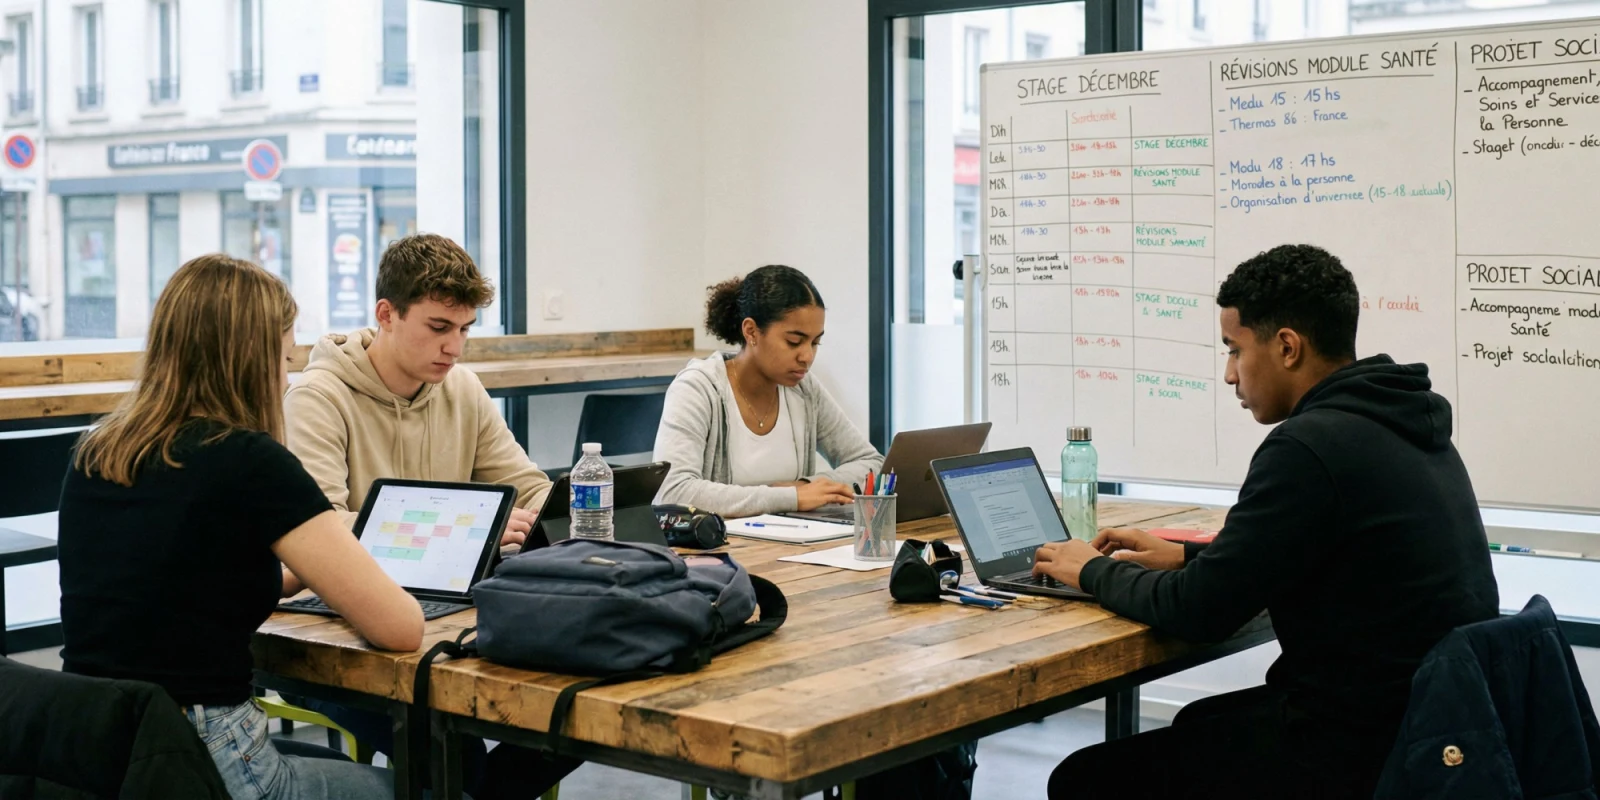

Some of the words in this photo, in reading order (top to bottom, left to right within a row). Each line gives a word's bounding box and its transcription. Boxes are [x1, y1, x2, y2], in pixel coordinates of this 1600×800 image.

[1471, 39, 1542, 64] PROJET
[1554, 33, 1600, 57] SOCI
[1220, 58, 1298, 81] RÉVISIONS
[1308, 54, 1369, 75] MODULE
[1381, 42, 1438, 69] SANTÉ
[1017, 76, 1068, 99] STAGE
[1078, 69, 1161, 93] DÉCEMBRE
[1270, 91, 1286, 105] 15
[1303, 88, 1321, 102] 15
[1479, 97, 1518, 112] Soins
[1525, 94, 1539, 109] et
[1313, 109, 1348, 122] France
[1480, 116, 1494, 131] la
[1502, 114, 1568, 130] Personne
[1134, 139, 1160, 149] STAGE
[1166, 136, 1208, 149] DÉCEMBRE
[1133, 166, 1169, 177] RÉVISIONS
[1171, 168, 1200, 176] MODULE
[1230, 159, 1261, 174] Modu
[1267, 156, 1283, 170] 18
[1300, 154, 1316, 167] 17
[1152, 177, 1177, 187] SANTÉ
[1292, 173, 1302, 186] la
[1306, 173, 1355, 191] personne
[1230, 192, 1297, 214] Organisation
[1135, 224, 1177, 236] RÉVISIONS
[1136, 238, 1165, 247] MODULE
[1467, 262, 1532, 284] PROJET
[991, 296, 1008, 310] 15h
[1135, 292, 1161, 303] STAGE
[1156, 306, 1184, 319] SANTÉ
[1470, 298, 1561, 322] Accompagneme
[1568, 303, 1600, 319] mod
[1510, 321, 1552, 337] Santé
[1473, 343, 1513, 367] Projet
[991, 372, 1010, 386] 18h
[1135, 373, 1160, 385] STAGE
[1167, 375, 1208, 391] DÉCEMBRE
